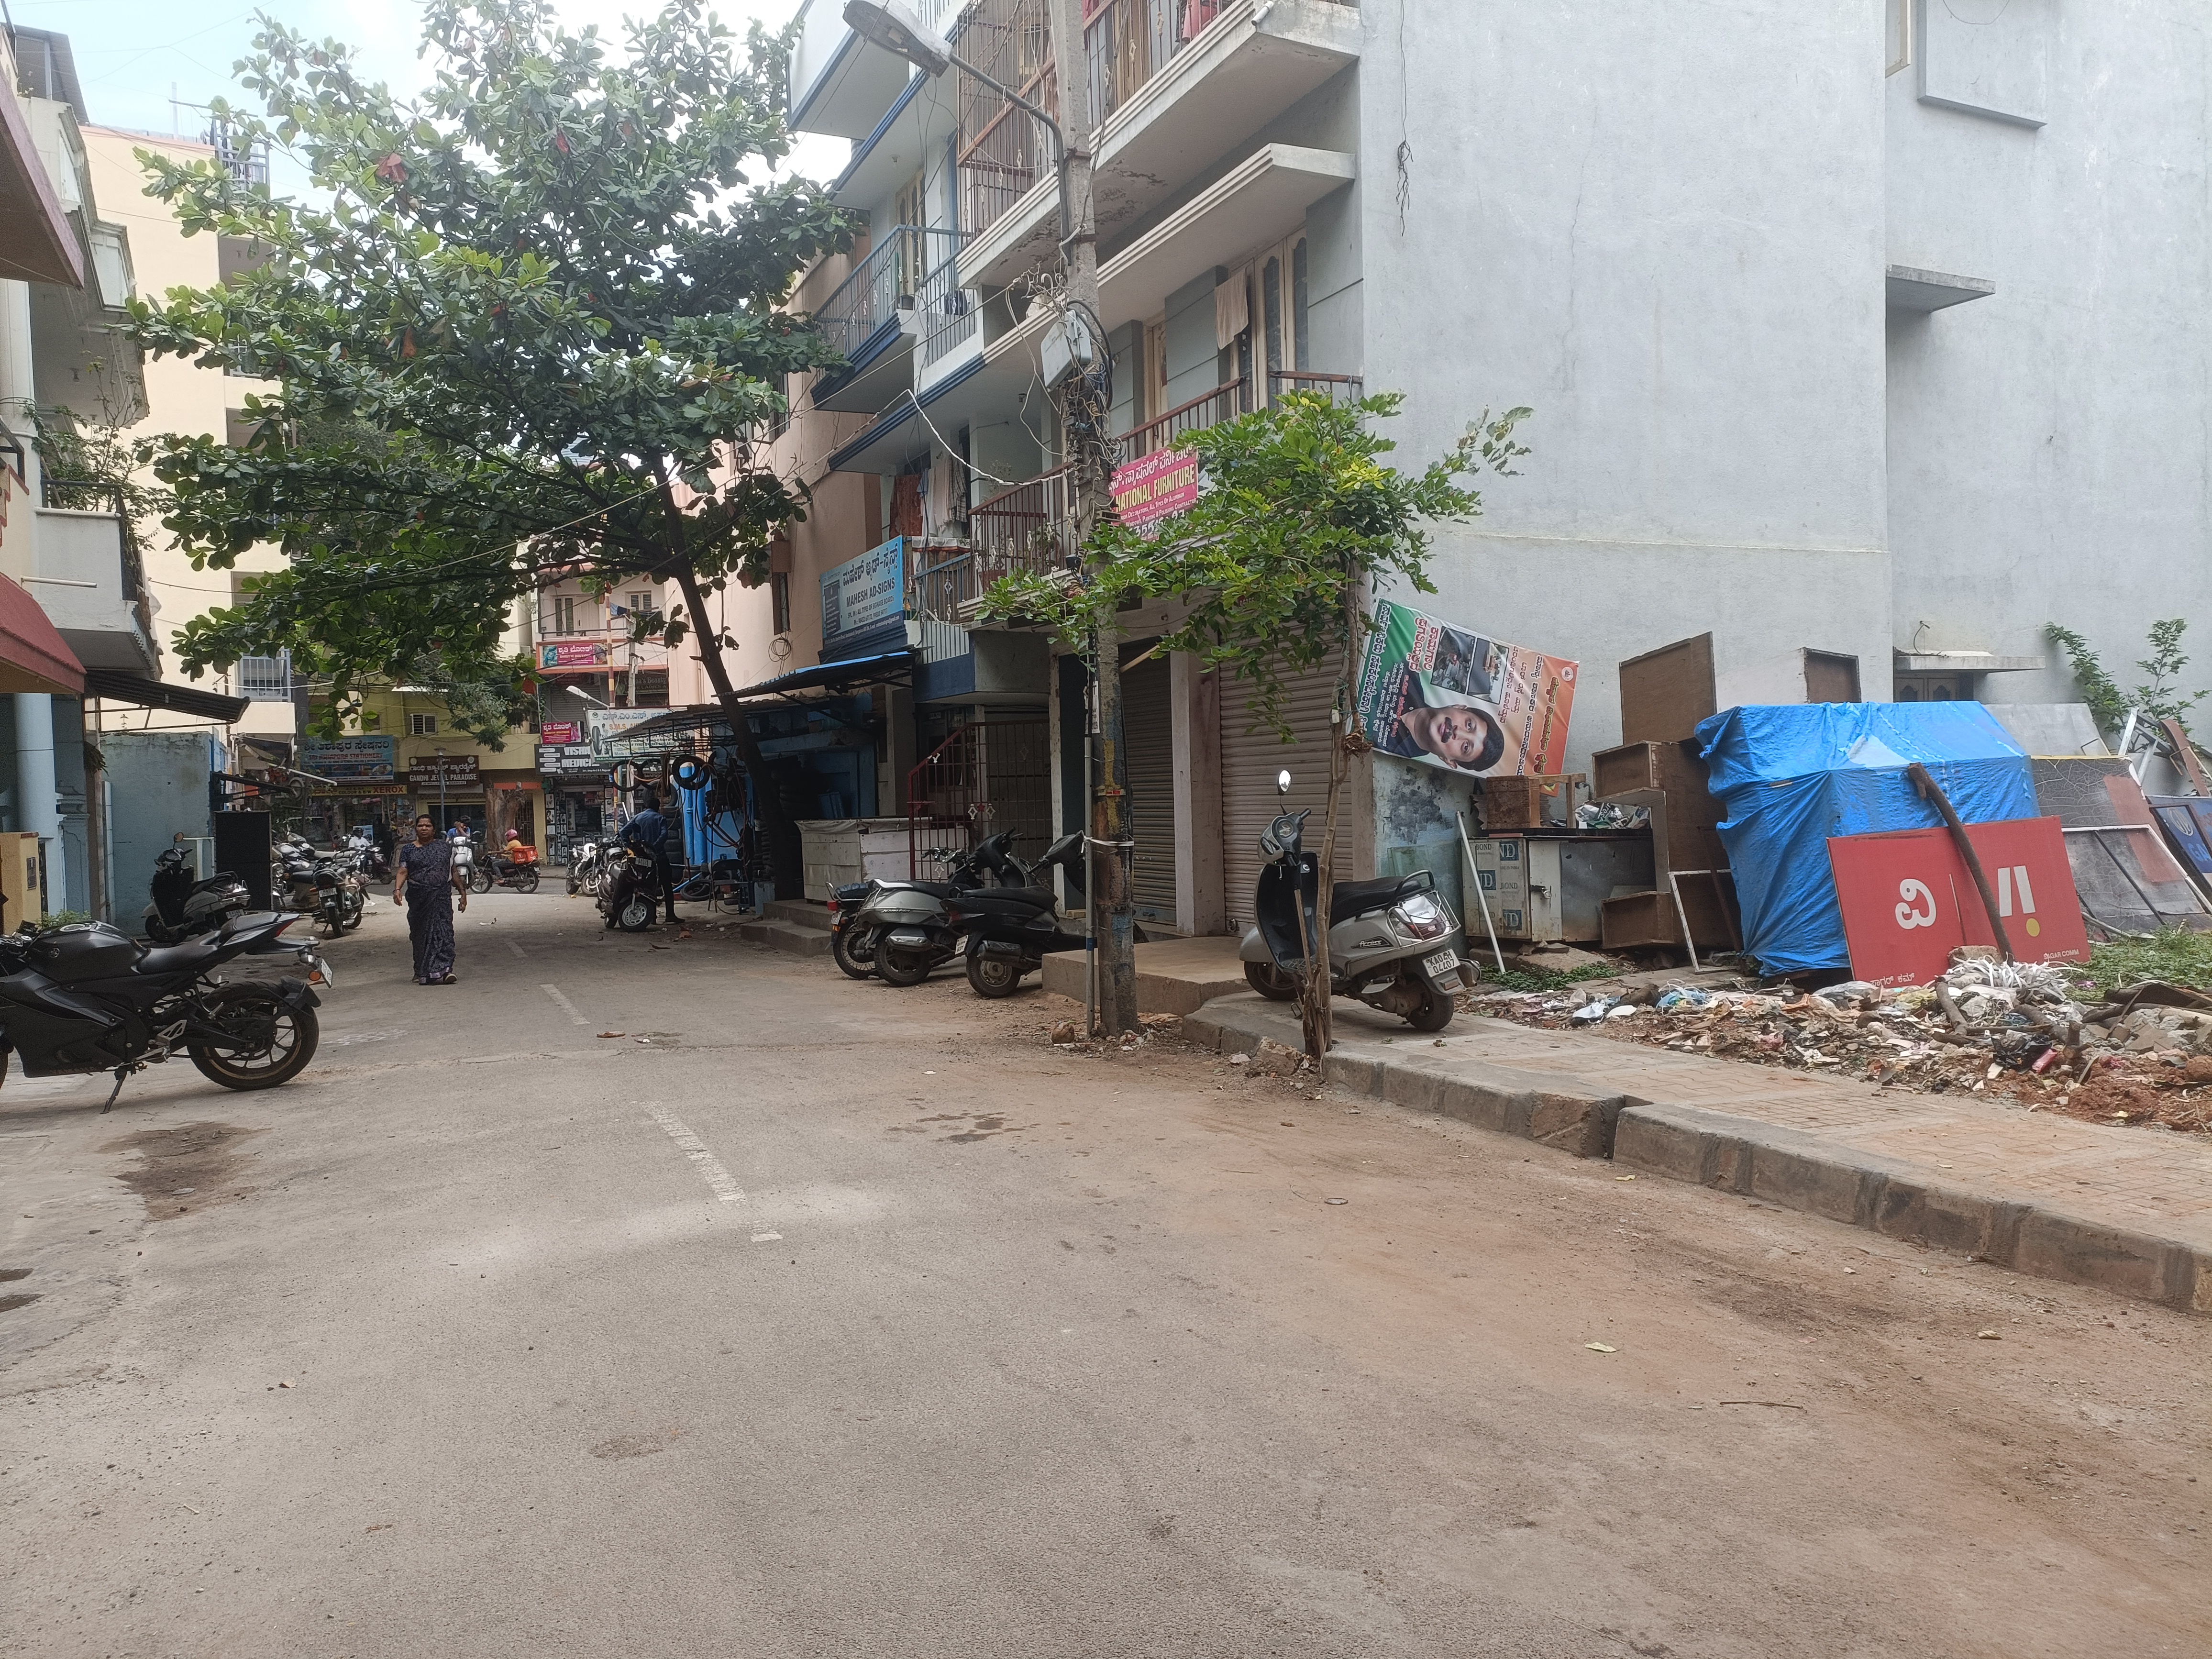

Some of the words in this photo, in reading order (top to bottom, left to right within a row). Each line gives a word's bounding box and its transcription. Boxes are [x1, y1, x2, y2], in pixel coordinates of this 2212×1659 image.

[1116, 482, 1152, 513] NATIONAL
[1154, 463, 1195, 499] FURNITURE
[846, 588, 868, 608] MAHESH
[869, 577, 895, 599] AD-SIGNS
[1407, 618, 1427, 672] ಪ್ರಗತಿಯಲ್ಲಿದೆ
[1424, 627, 1439, 670] ಕಾಮಗಾರಿ
[1531, 656, 1543, 678] ಮಾನ್ಯ
[1360, 655, 1380, 713] ಸಹಕರಿಸಬೇಕಾಗಿ
[1514, 683, 1524, 695] ರಸ್ತೆ
[1529, 682, 1538, 712] ಶಾಸಕರ
[1511, 697, 1521, 714] ಮತ್ತು
[564, 746, 591, 755] VISHA
[1516, 715, 1533, 775] ಅನುದಾನದಾಡಿಯ
[373, 785, 404, 794] XEROX
[1895, 878, 1936, 930] ವಿ
[2043, 951, 2062, 960] SAGAR
[2062, 949, 2079, 958] COMM
[1897, 972, 1915, 984] ಕಮ್
